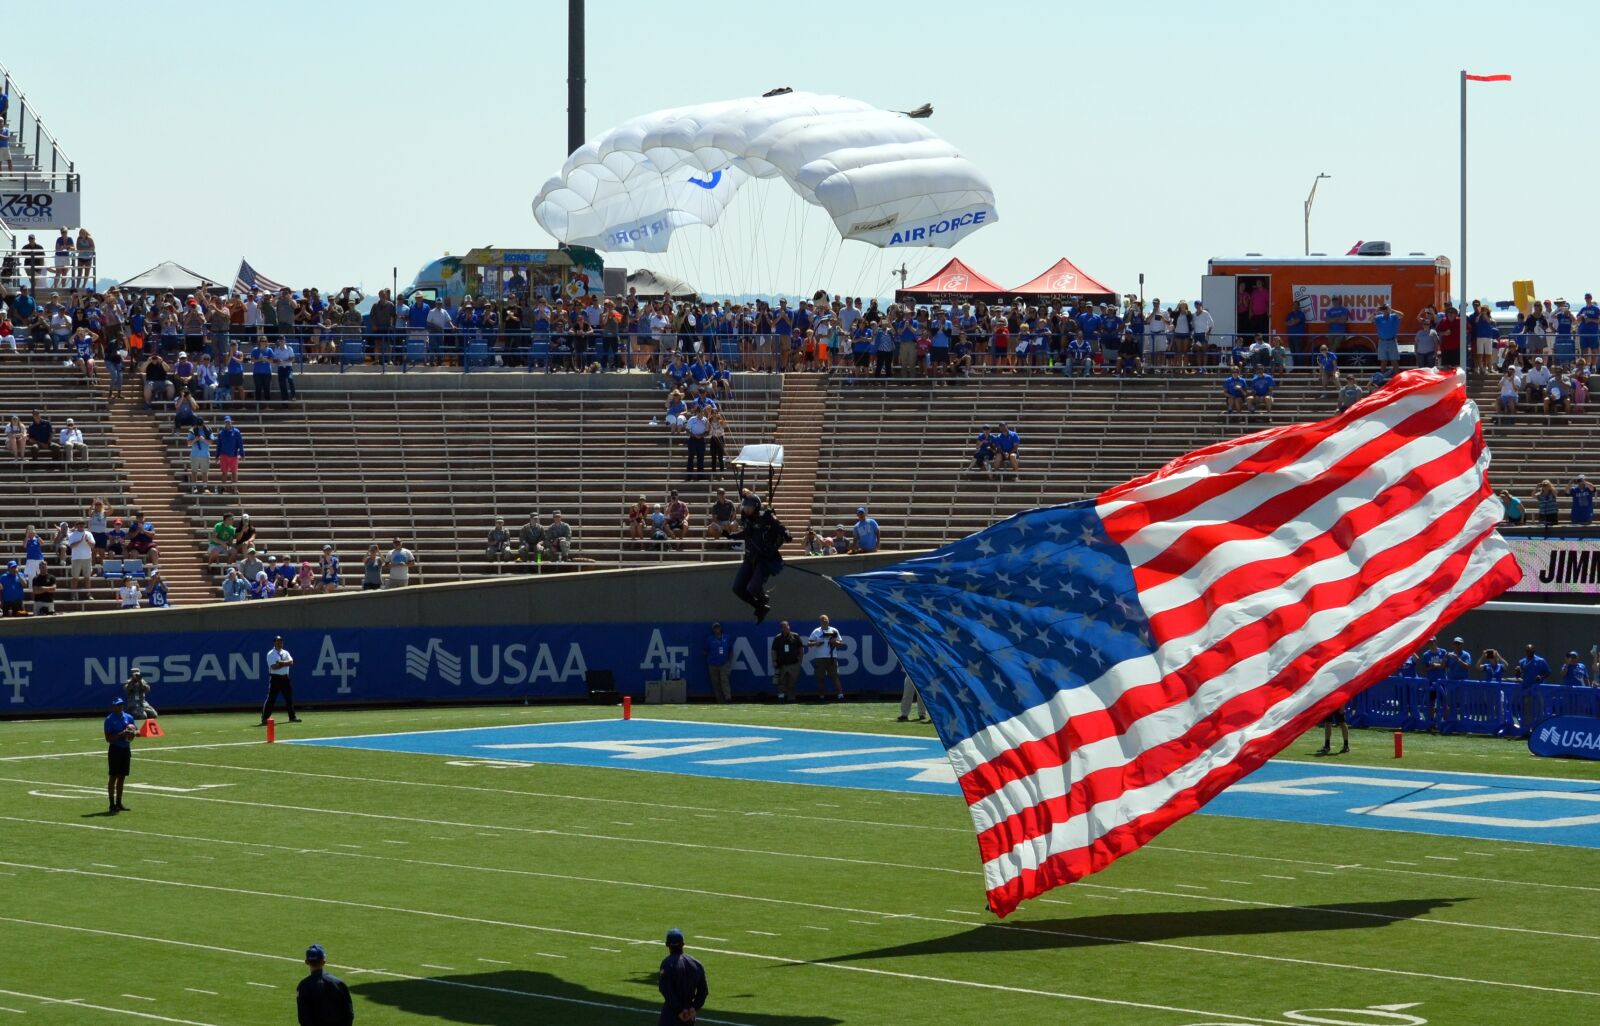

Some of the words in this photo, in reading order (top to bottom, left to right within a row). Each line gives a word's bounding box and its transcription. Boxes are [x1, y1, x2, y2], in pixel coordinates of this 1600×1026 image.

[889, 227, 926, 245] AIR
[928, 211, 987, 237] FORCE
[152, 592, 164, 605] 19
[84, 652, 260, 686] NISSAN
[311, 634, 360, 694] AF
[470, 642, 588, 685] USAA
[640, 628, 689, 682] AF
[148, 722, 159, 738] G
